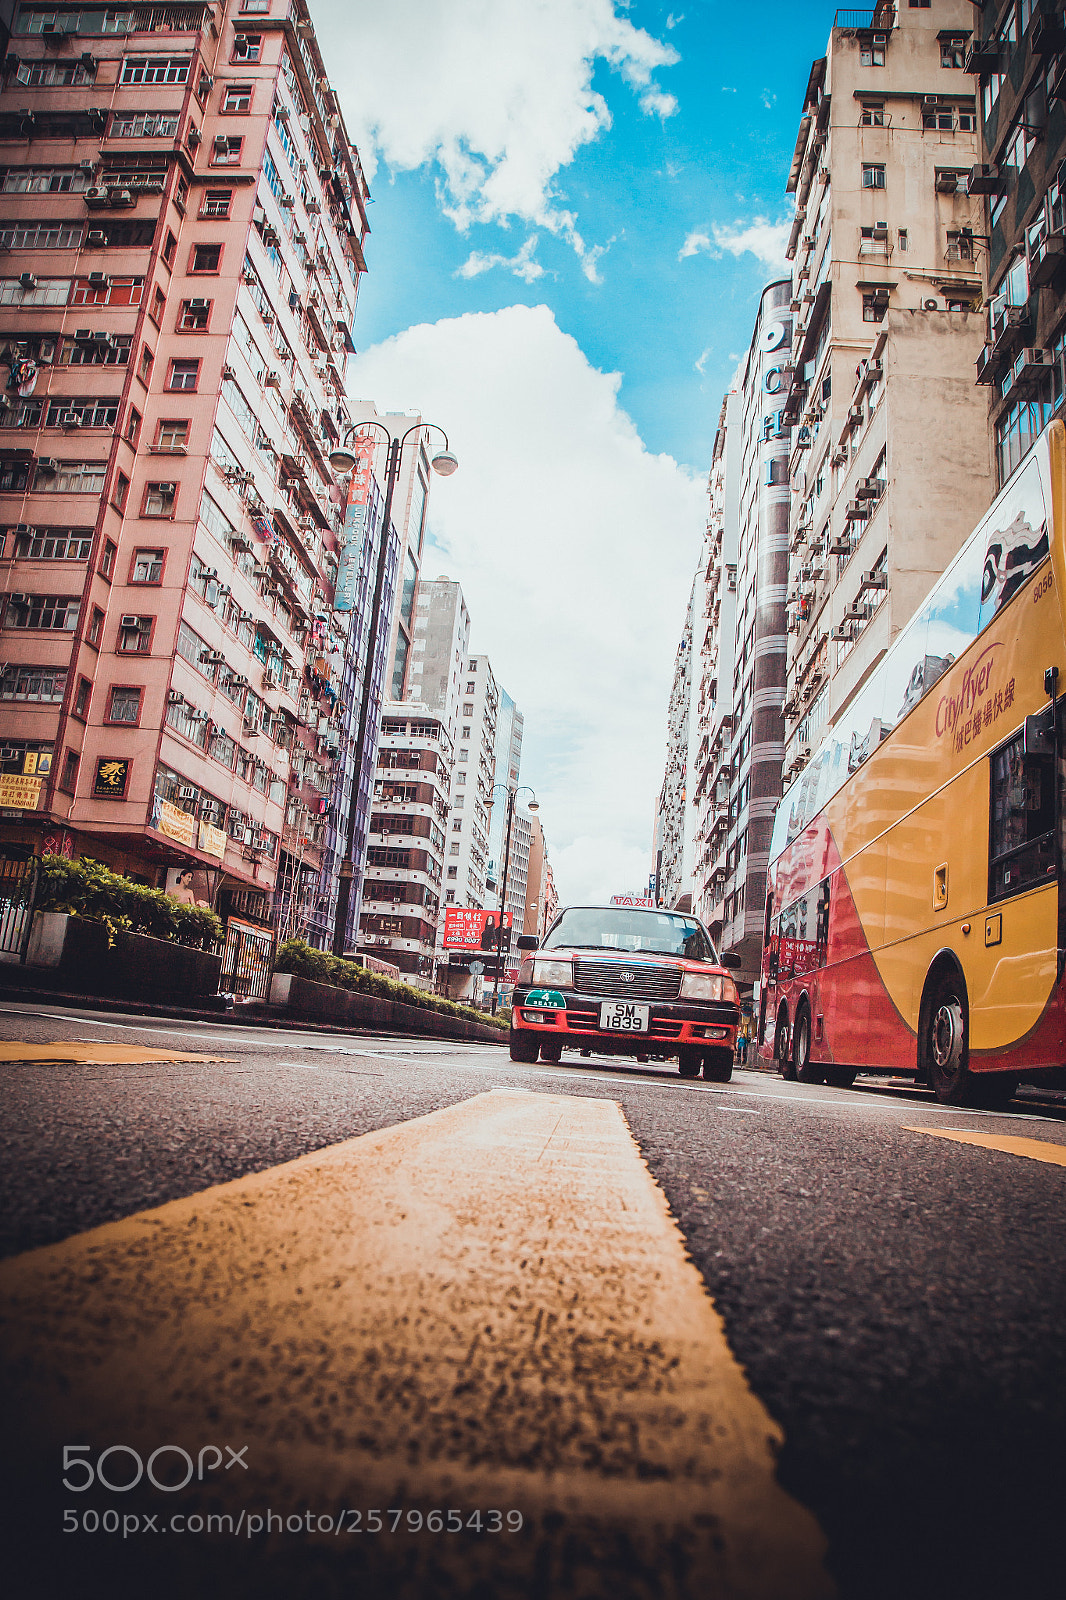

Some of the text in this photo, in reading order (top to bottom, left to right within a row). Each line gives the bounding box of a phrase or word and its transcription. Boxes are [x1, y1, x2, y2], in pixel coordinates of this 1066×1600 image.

[1033, 571, 1053, 603] 8056
[955, 676, 1016, 753] 城巴機場快線
[613, 895, 654, 908] TAXI
[541, 993, 550, 1002] 4
[615, 1004, 636, 1018] SM
[606, 1015, 642, 1030] 1839
